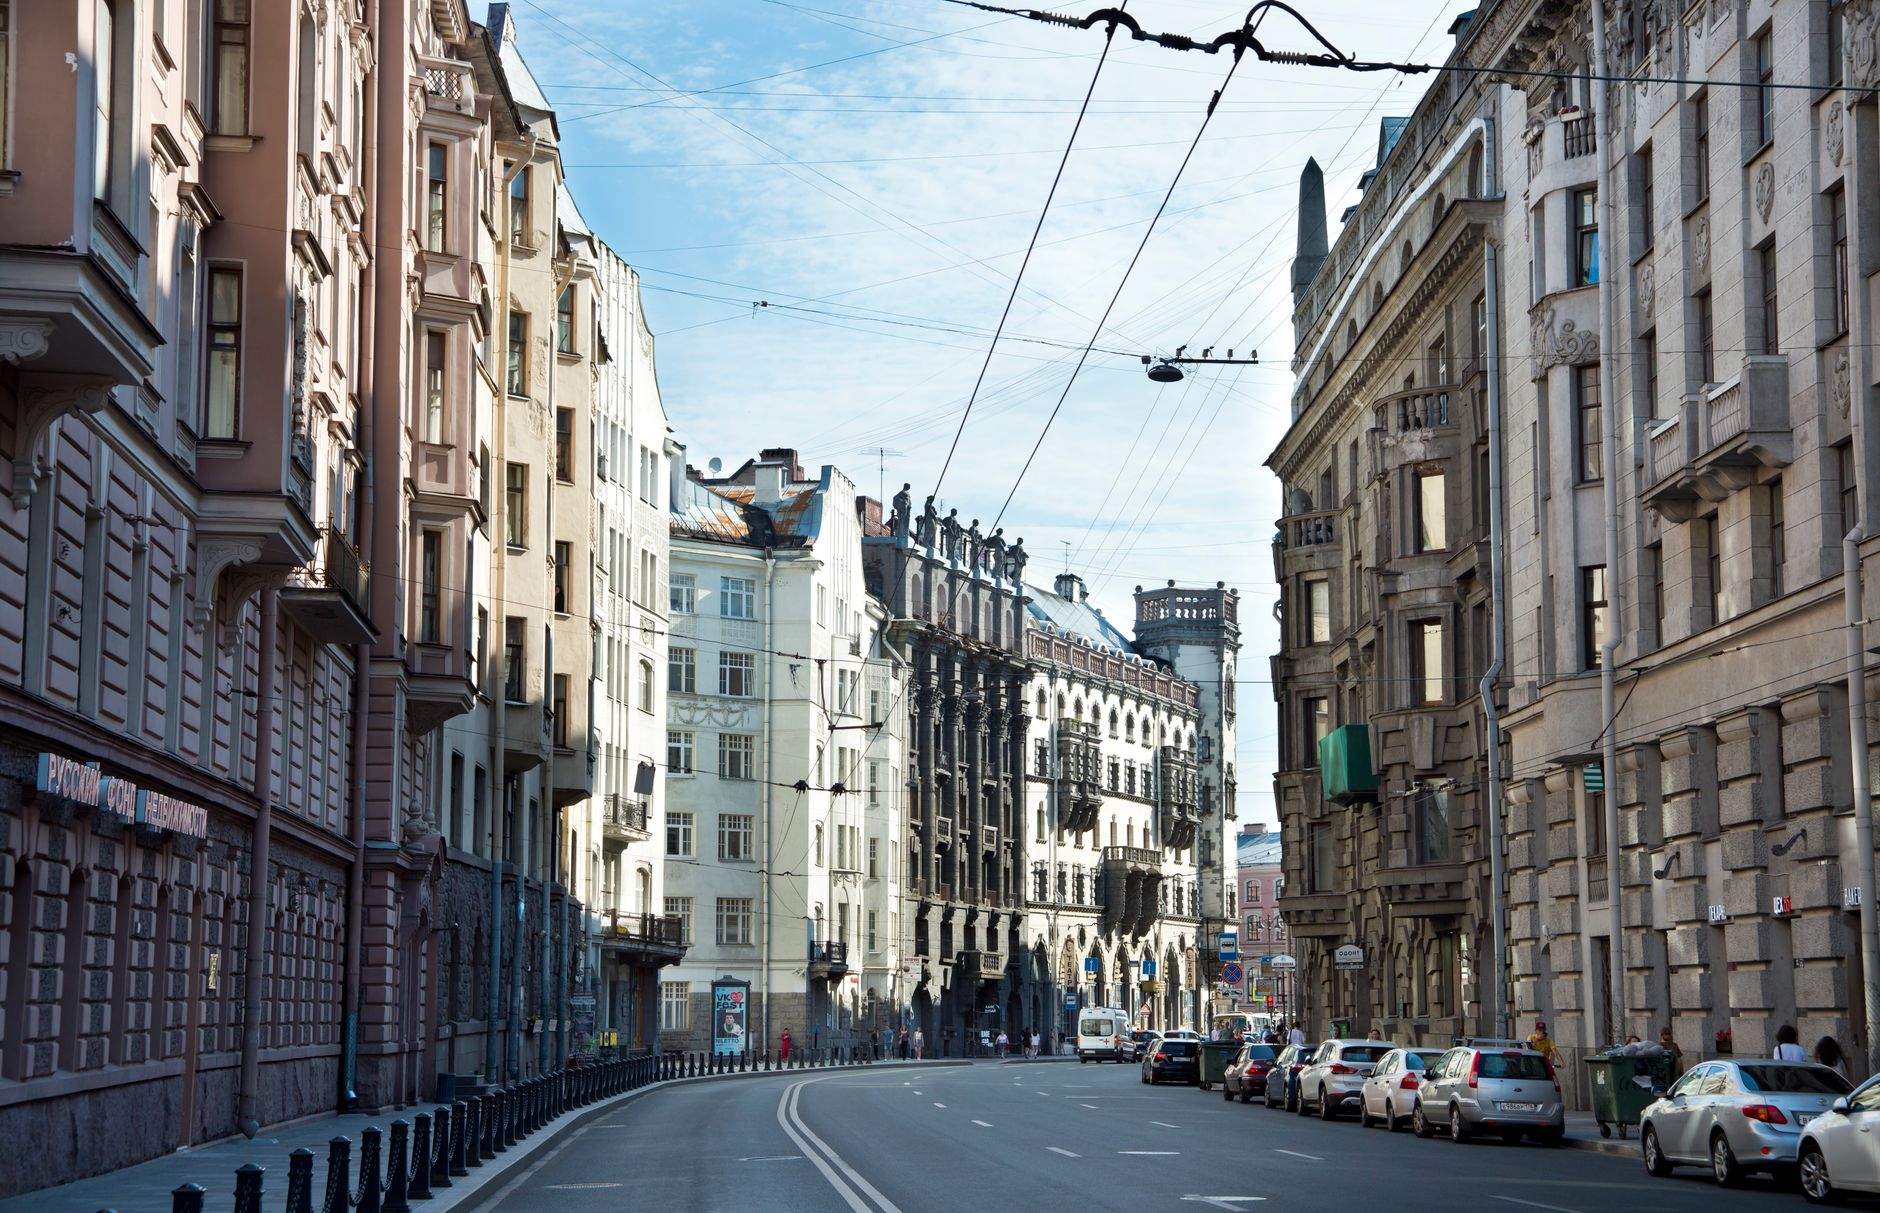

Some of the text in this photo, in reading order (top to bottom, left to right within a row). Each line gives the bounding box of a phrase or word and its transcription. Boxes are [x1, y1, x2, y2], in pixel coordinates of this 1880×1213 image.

[48, 752, 208, 839] РУССКИЙ ФОНД НЕДВИЖИМОСТИ
[716, 993, 731, 1002] VK
